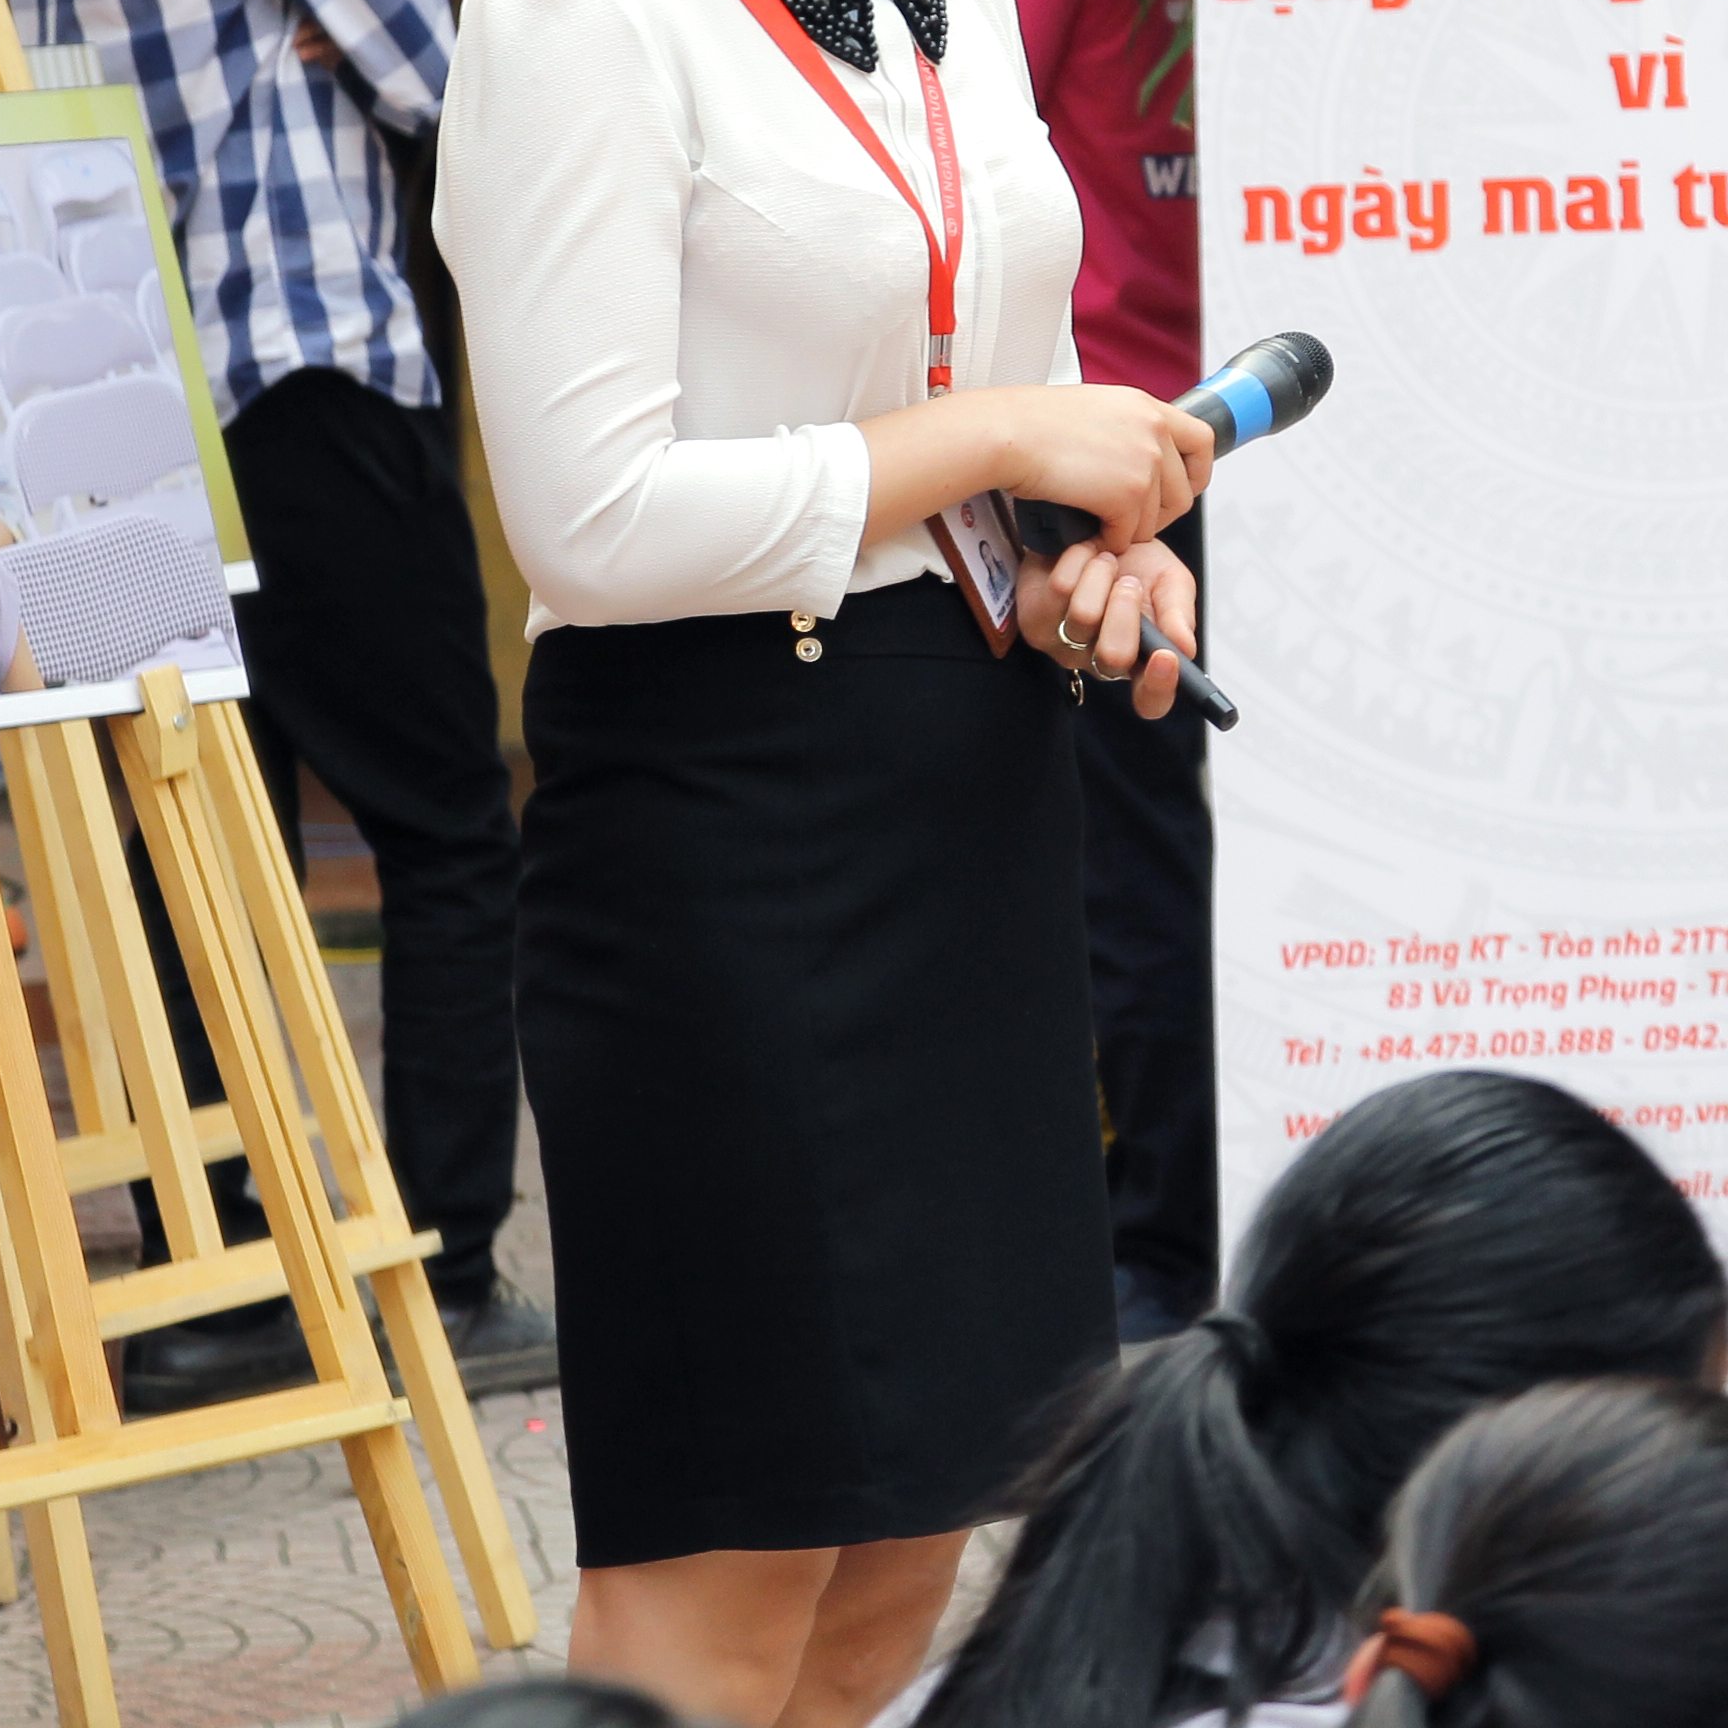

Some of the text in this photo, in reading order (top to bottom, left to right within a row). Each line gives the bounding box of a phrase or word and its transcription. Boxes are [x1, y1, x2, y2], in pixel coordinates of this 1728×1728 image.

[1609, 37, 1686, 109] vì
[933, 122, 949, 149] MAI
[1244, 168, 1448, 255] ngày
[1483, 162, 1642, 234] mai
[1281, 940, 1374, 969] VPĐD:
[1470, 934, 1510, 960] KT
[1539, 932, 1594, 958] Tòa
[1603, 930, 1661, 955] nhà
[1387, 982, 1423, 1009] 83
[1483, 978, 1569, 1010] Trọng
[1578, 975, 1677, 1006] Phụng
[1360, 1028, 1614, 1062] +84.473.003.888
